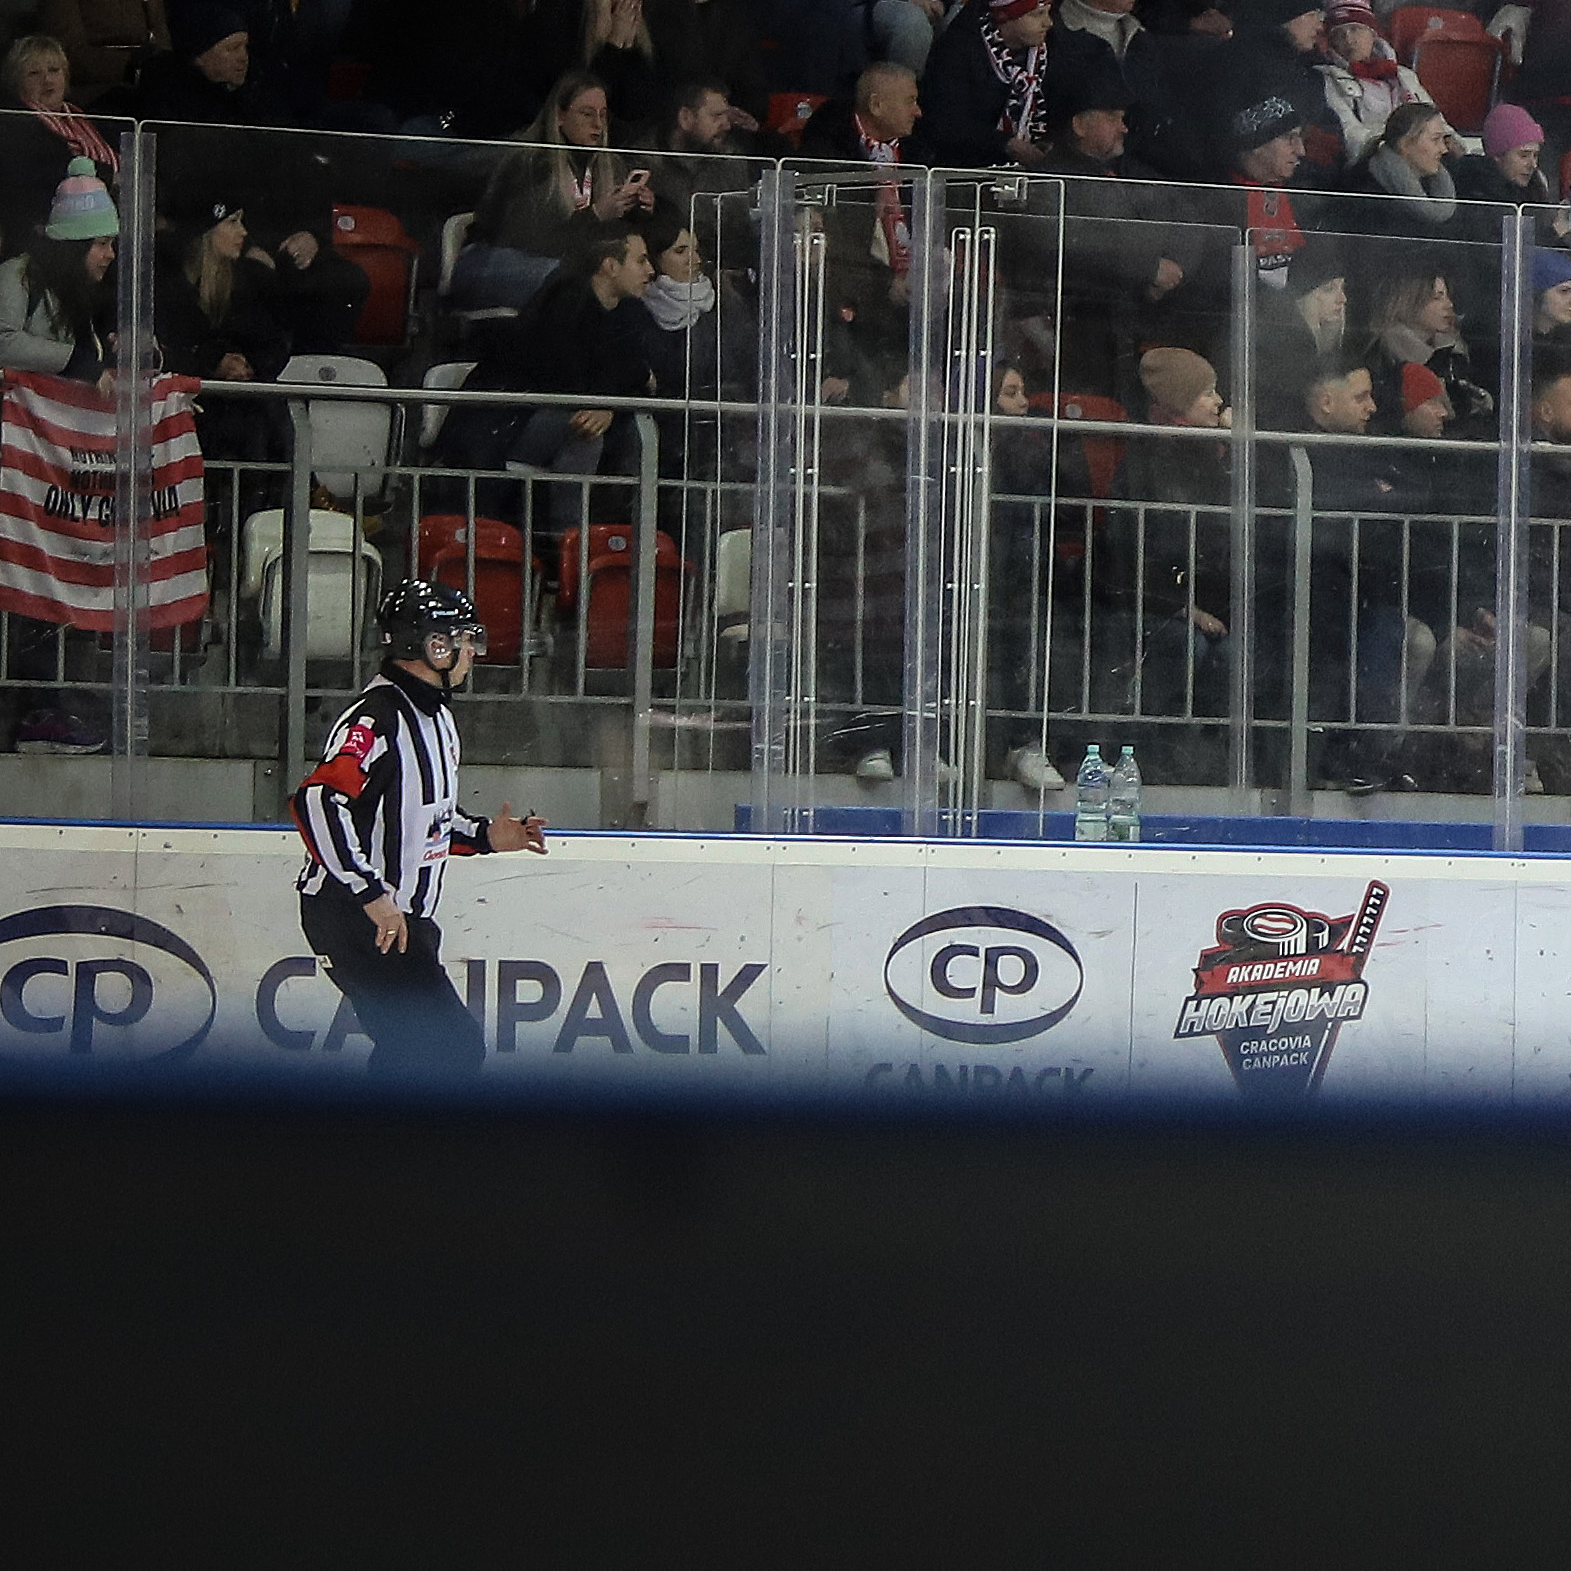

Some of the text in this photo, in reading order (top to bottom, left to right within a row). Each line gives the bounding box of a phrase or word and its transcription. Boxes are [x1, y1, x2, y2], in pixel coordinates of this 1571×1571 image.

[1226, 958, 1321, 984] AKADEMIA
[1239, 1034, 1312, 1055] CRACOVIA
[1242, 1051, 1310, 1071] CANPACK
